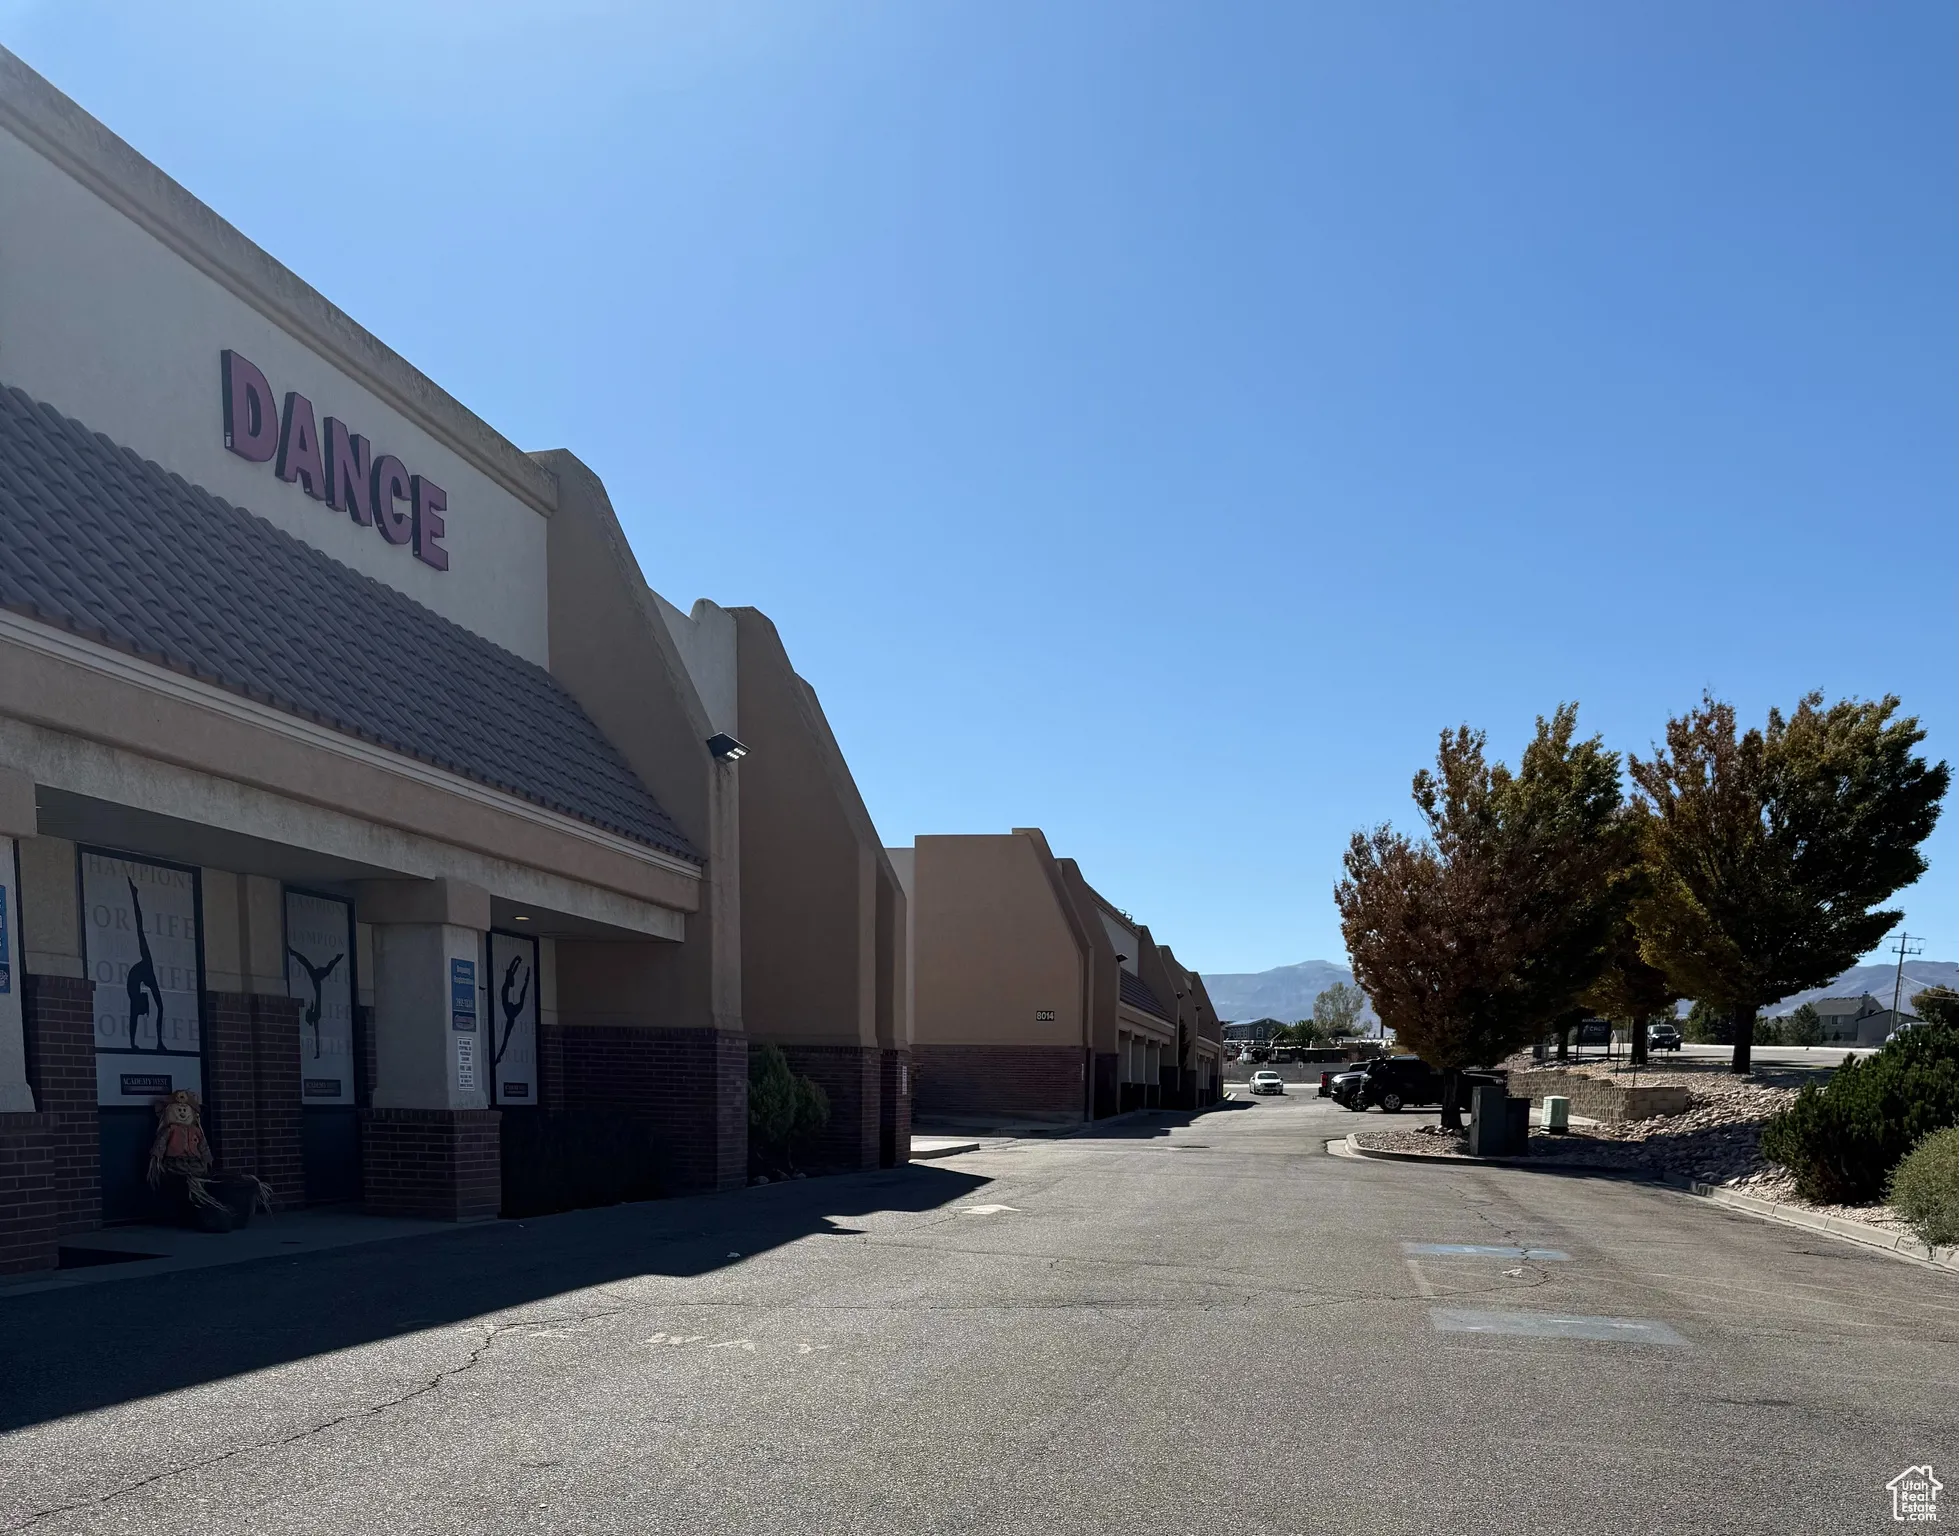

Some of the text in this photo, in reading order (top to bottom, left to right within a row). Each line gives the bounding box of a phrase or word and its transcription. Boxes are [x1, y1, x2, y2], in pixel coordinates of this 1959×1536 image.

[221, 349, 448, 571] DANCE
[85, 903, 131, 931] OR
[1036, 1011, 1054, 1020] 8014
[123, 1077, 152, 1085] ACADEMY
